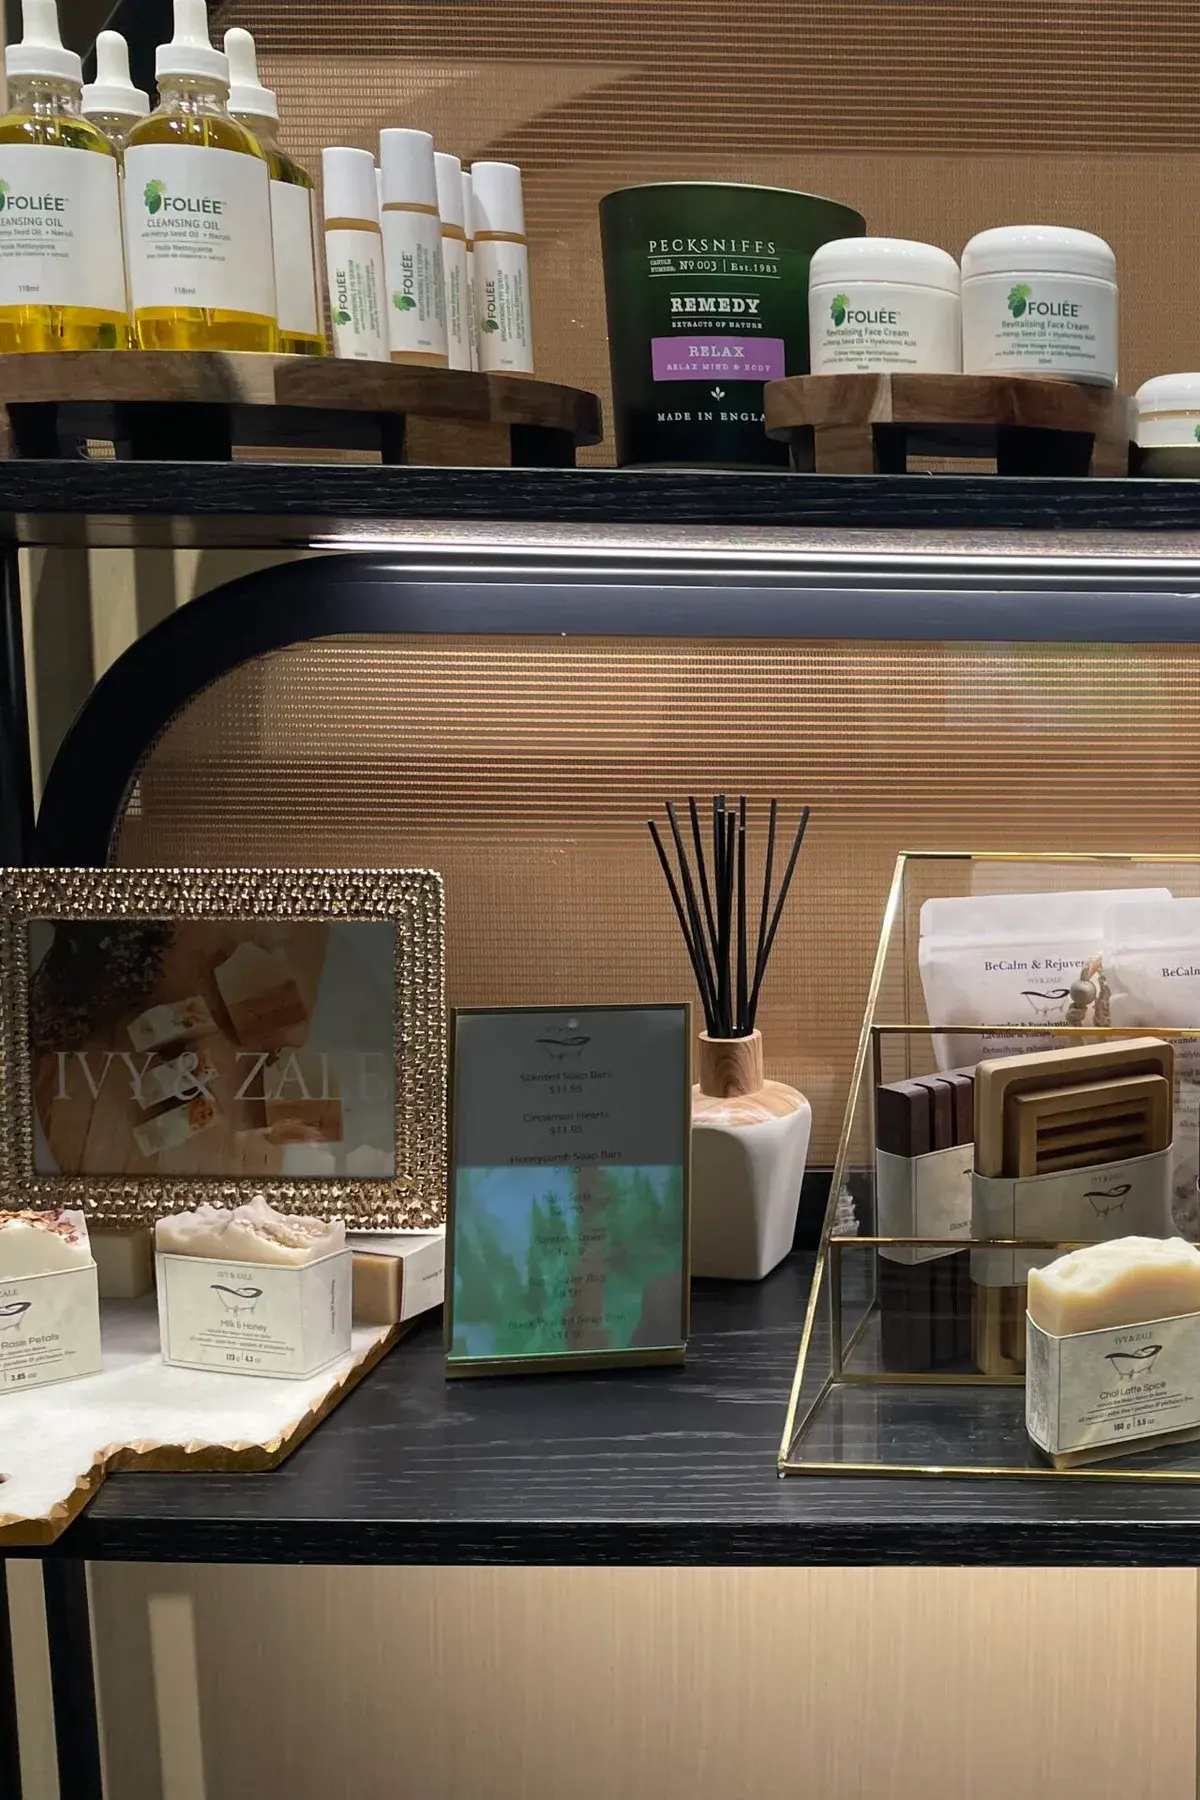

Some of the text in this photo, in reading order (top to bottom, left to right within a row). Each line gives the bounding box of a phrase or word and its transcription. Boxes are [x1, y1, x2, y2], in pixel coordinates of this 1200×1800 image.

[7, 193, 65, 212] FOLIÉE
[163, 196, 223, 215] FOLIÉE
[0, 217, 63, 228] EANSING OIL
[147, 218, 221, 231] CLEANSING OIL
[649, 239, 776, 255] PECKSNIFFS
[697, 260, 718, 272] 003
[400, 254, 414, 295] FOLIÉE
[336, 270, 348, 310] FOLIÉE
[486, 280, 497, 318] FOLIÉE
[670, 297, 761, 314] REMEDY
[847, 307, 897, 325] FOLIÉE
[1028, 301, 1079, 318] FOLIÉE
[672, 321, 714, 329] EXTRACTS
[1002, 320, 1090, 330] Revitalising Face Cream
[865, 328, 882, 336] Face
[884, 329, 909, 337] Cream
[689, 346, 746, 358] RELAX
[744, 364, 772, 373] BODY
[657, 412, 766, 422] MADE IN ENGLA
[985, 960, 1028, 971] BeCalm
[1031, 959, 1042, 970] &
[53, 1050, 391, 1102] IVY & ZALE
[520, 1069, 612, 1082] Scented Soap Bars
[523, 1110, 611, 1122] Cinnamon Hearts
[510, 1149, 623, 1165] Honeycomb Soap Bars
[220, 1319, 236, 1329] Milk
[243, 1321, 268, 1333] Honey
[1, 1333, 60, 1350] Rose Petals
[1115, 1332, 1154, 1345] IVY & ZALE
[1100, 1391, 1119, 1400] Chai
[1120, 1386, 1142, 1396] Latte
[1143, 1381, 1167, 1392] Spice
